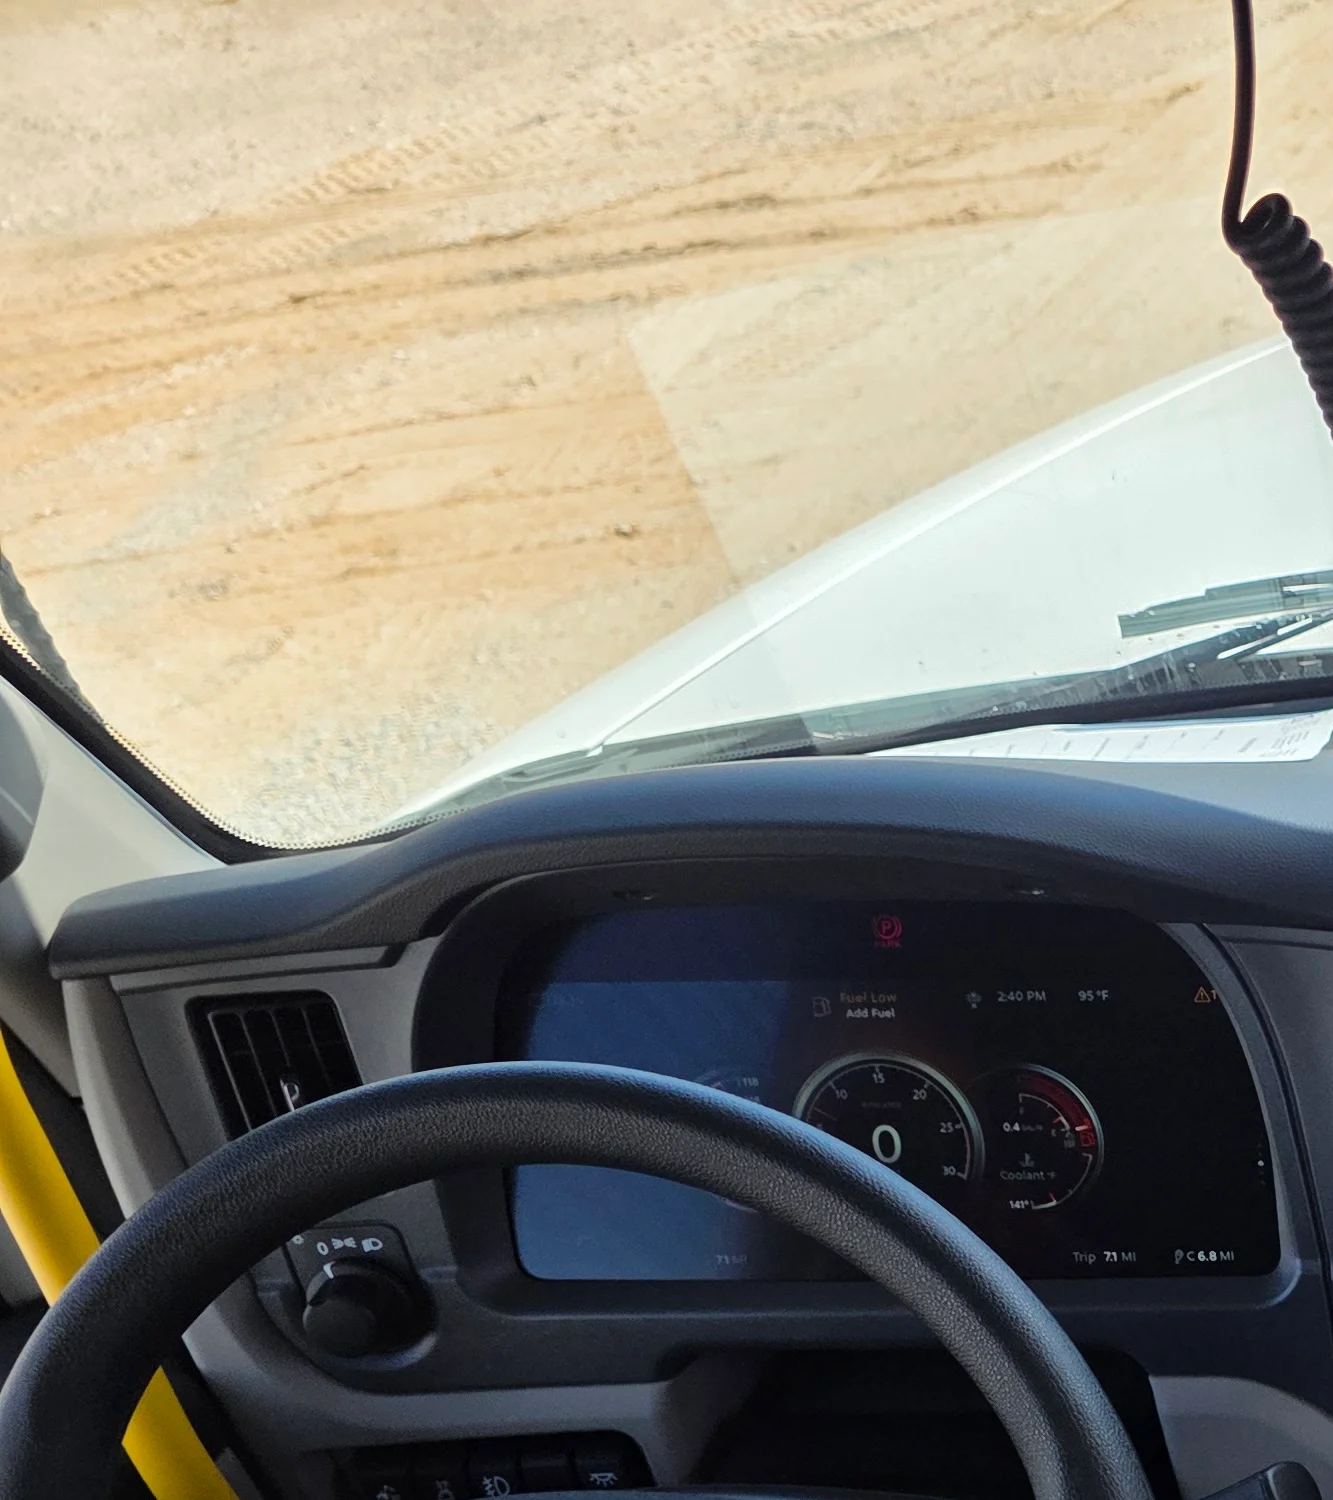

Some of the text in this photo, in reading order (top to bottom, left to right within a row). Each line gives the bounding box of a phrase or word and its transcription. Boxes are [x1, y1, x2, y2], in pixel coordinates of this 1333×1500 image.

[870, 992, 897, 1003] Low
[997, 990, 1046, 1001] 2:40 PM
[1077, 990, 1094, 1001] 95
[846, 1007, 896, 1018] Add Fuel
[872, 1073, 885, 1084] 15
[836, 1088, 848, 1099] 10
[912, 1089, 927, 1100] 20
[940, 1122, 953, 1133] 25
[1003, 1121, 1020, 1132] 0.4
[872, 1124, 901, 1164] 0
[943, 1165, 956, 1176] 30
[1000, 1171, 1045, 1181] Coolant
[1073, 1251, 1096, 1265] Trip
[1121, 1252, 1137, 1262] MI
[1197, 1250, 1217, 1262] 6.8
[1219, 1251, 1235, 1261] MI
